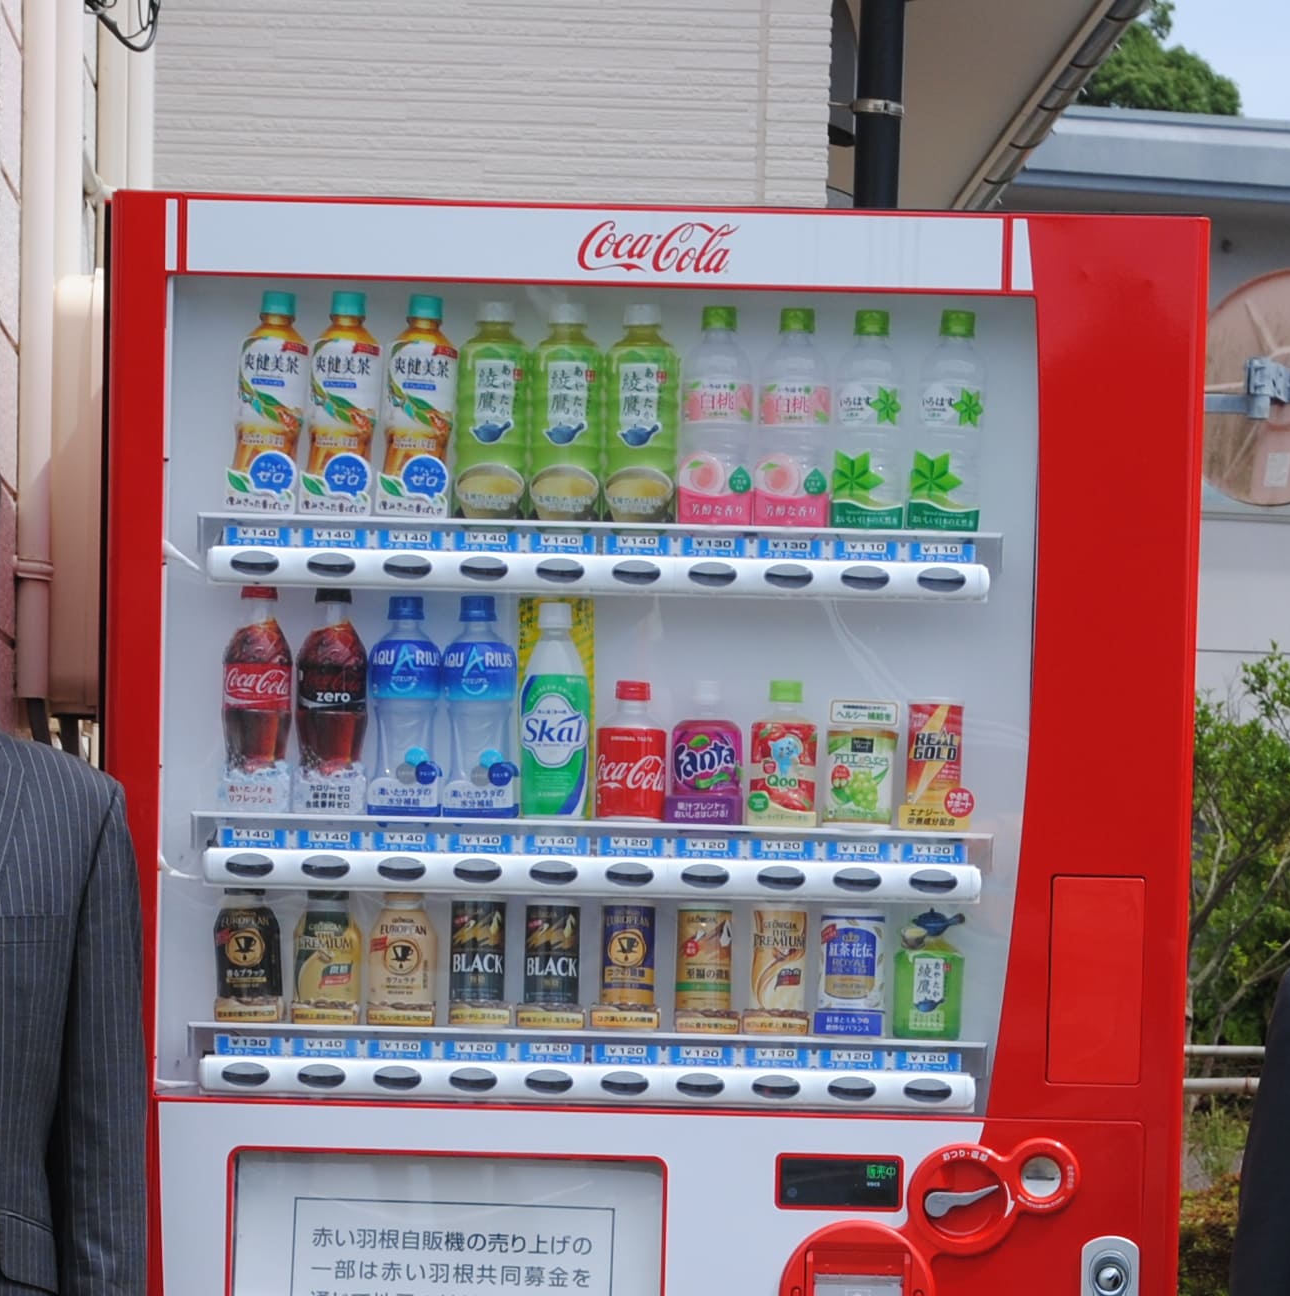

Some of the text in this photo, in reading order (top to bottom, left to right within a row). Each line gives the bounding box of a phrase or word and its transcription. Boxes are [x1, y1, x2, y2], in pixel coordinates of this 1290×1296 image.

[577, 220, 741, 273] Coca-Cola
[244, 353, 299, 375] 爽健美茶
[316, 354, 371, 376] 爽健美茶
[394, 356, 449, 378] 爽健美茶
[478, 367, 500, 414] 綾鷹
[500, 364, 512, 418] あやたか
[551, 369, 573, 416] 綾鷹
[574, 366, 585, 419] あやたか
[622, 371, 644, 417] 綾鷹
[644, 367, 655, 421] あやたか
[700, 391, 734, 410] 白桃
[775, 395, 810, 413] 白桃
[372, 643, 440, 675] AQUARIUS
[444, 646, 512, 677] AQUARIUS
[226, 667, 289, 695] Coca-Cola
[316, 691, 351, 703] zero
[914, 728, 958, 747] REAL
[674, 740, 736, 784] Fanta
[913, 746, 958, 761] GOLD
[597, 754, 664, 791] Coca-Cola
[767, 775, 798, 788] Qoo
[753, 934, 805, 947] PREMIUM
[829, 943, 874, 958] 紅茶花伝
[452, 953, 503, 974] BLACK
[526, 956, 577, 977] BLACK
[917, 963, 933, 994] 綾鷹
[312, 1227, 592, 1256] 赤い羽根自販機の売り上げの
[311, 1259, 591, 1289] 一部は赤い羽根共同募金を
